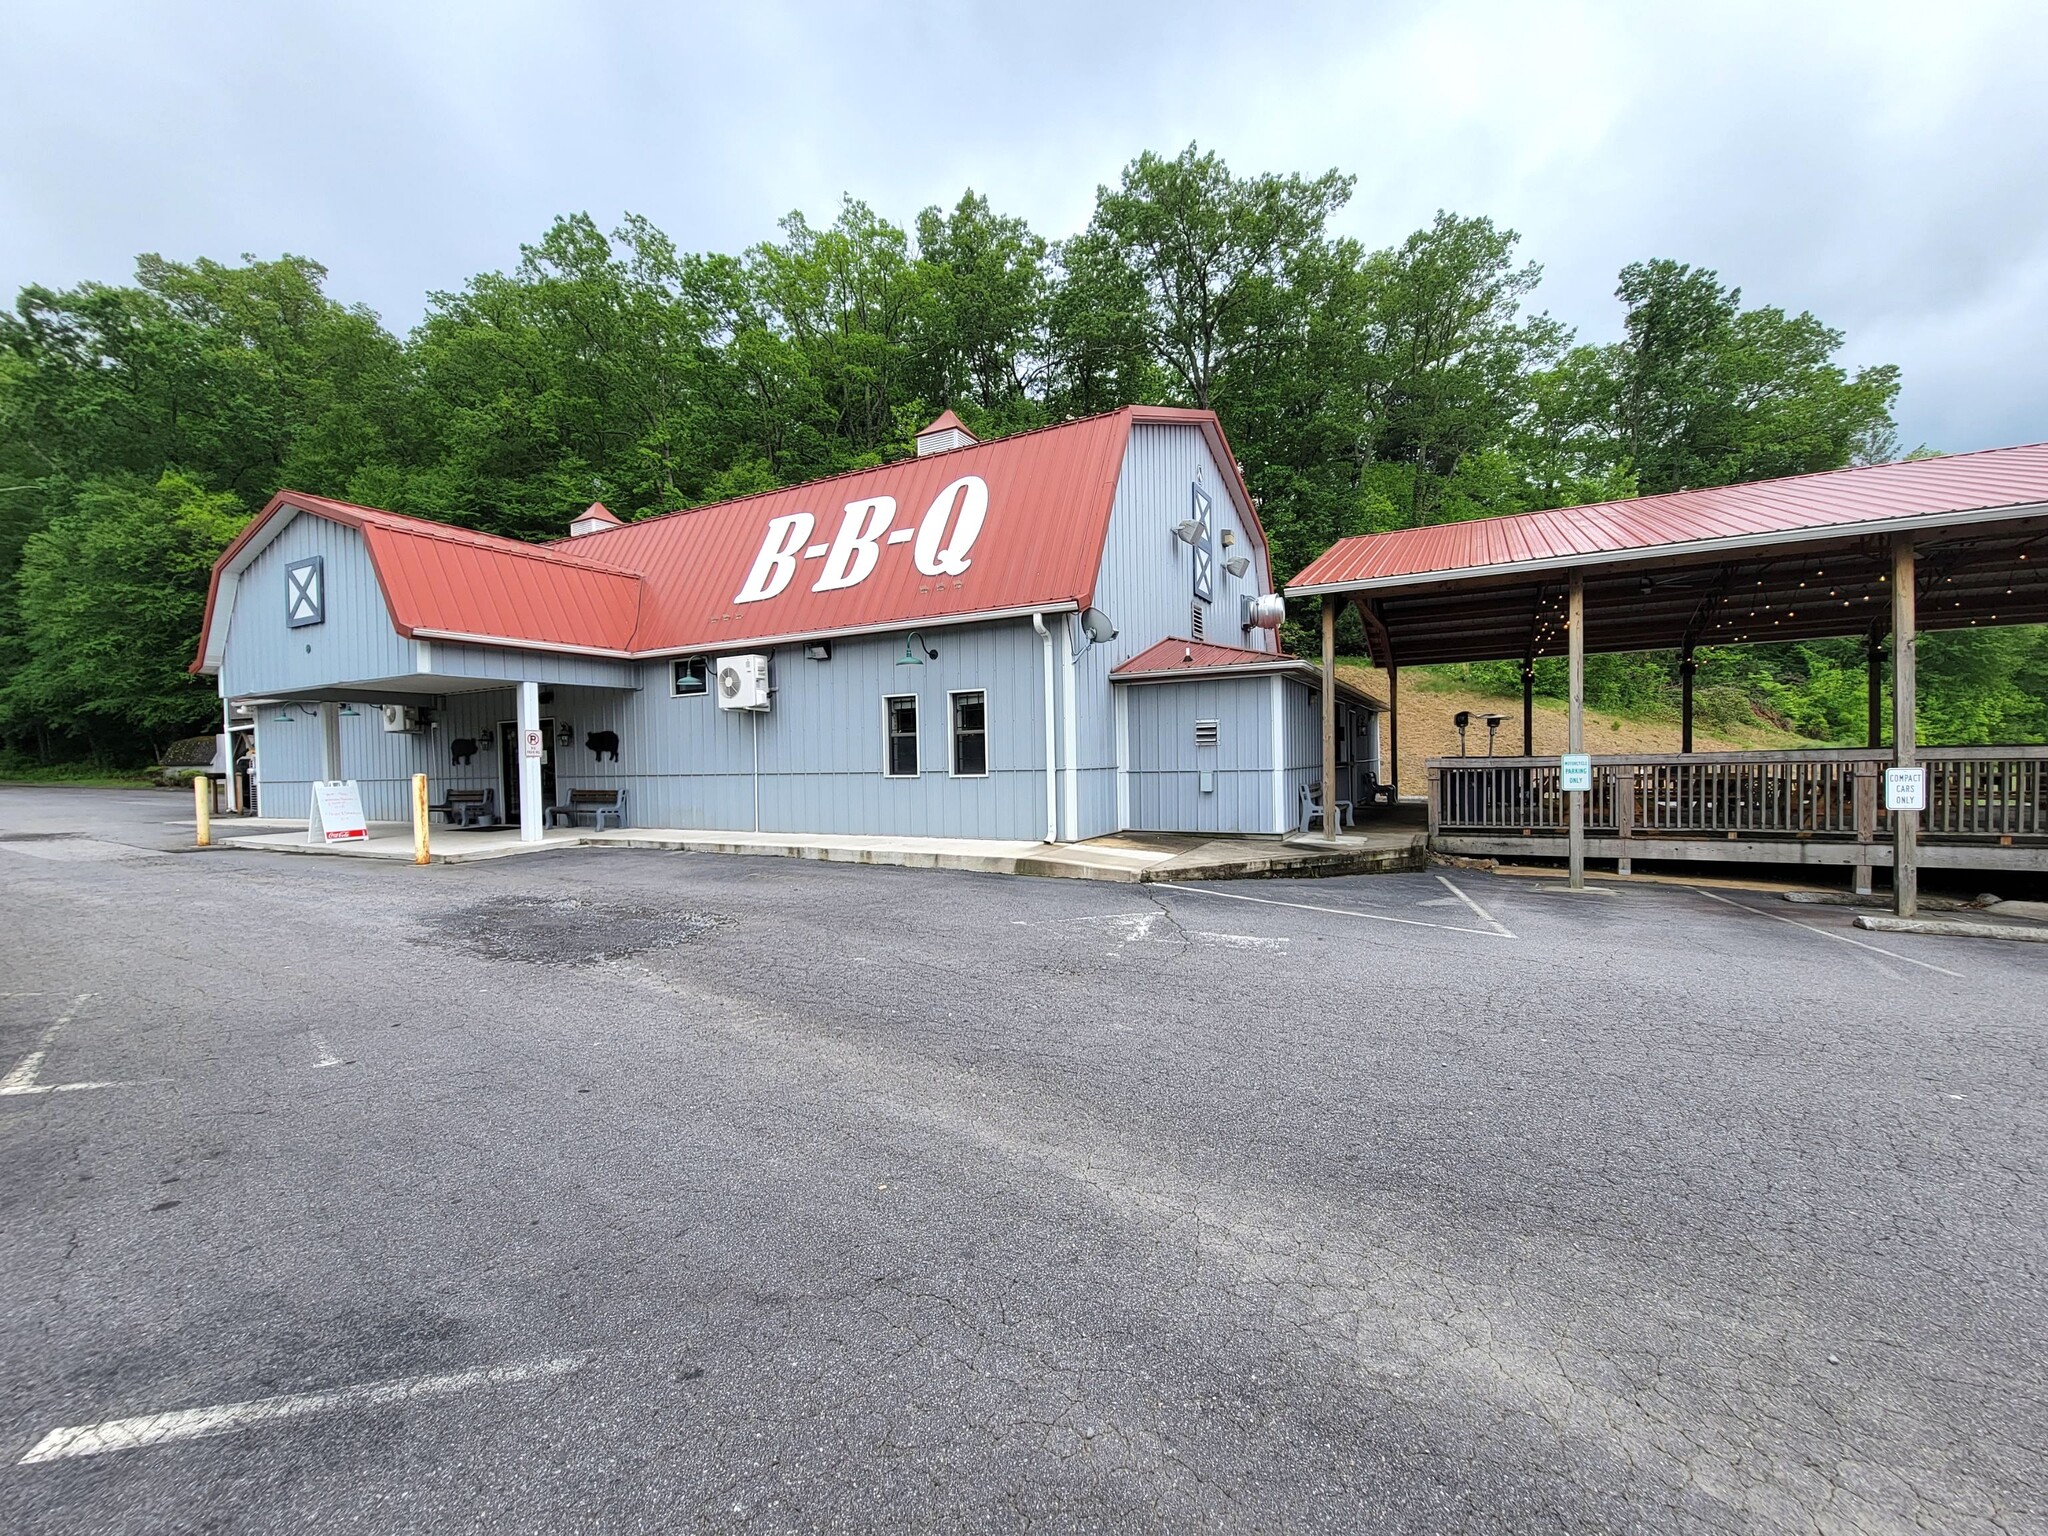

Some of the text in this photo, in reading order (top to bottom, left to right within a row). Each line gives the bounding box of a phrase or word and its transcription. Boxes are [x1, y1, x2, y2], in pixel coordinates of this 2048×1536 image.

[733, 475, 989, 605] B-B-Q
[1890, 774, 1922, 782] COMPACT
[1896, 785, 1915, 793] CARS
[1896, 796, 1915, 804] ONLY
